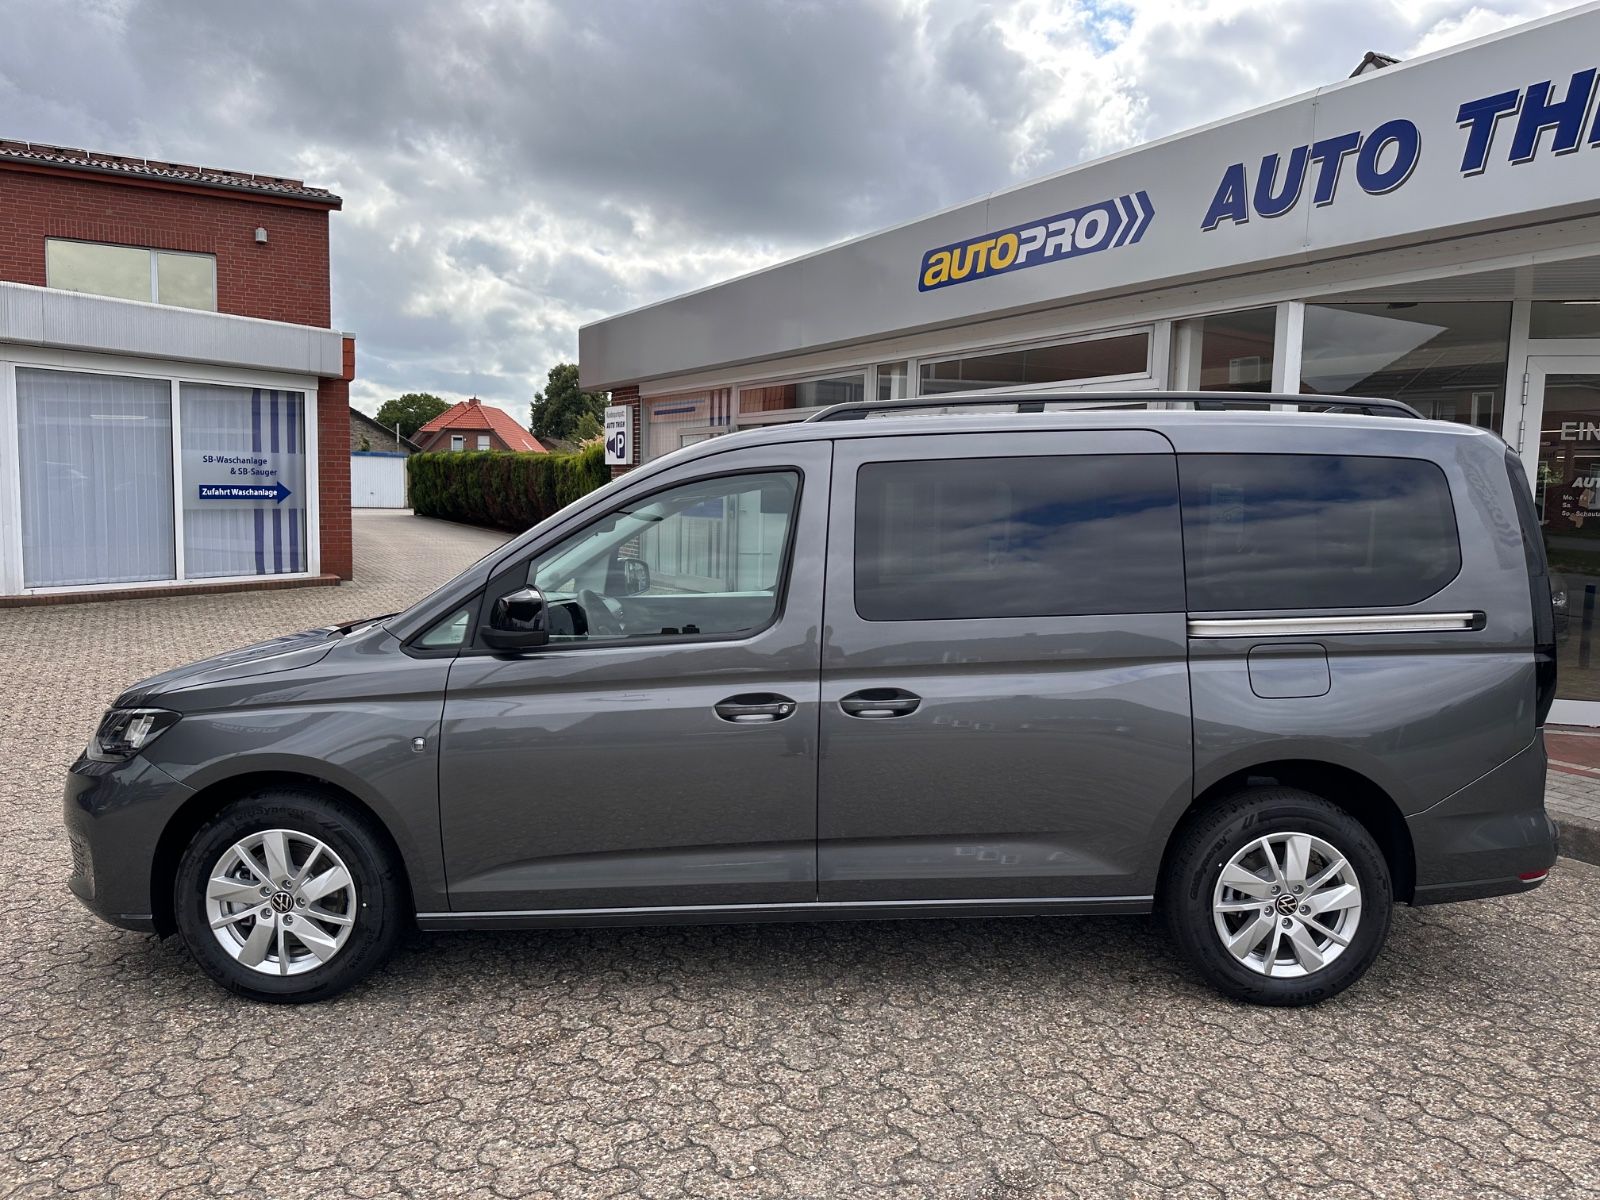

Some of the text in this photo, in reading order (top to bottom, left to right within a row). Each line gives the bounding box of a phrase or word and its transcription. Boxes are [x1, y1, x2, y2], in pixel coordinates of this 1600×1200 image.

[1200, 67, 1600, 232] AUTO TH
[617, 434, 624, 456] P
[202, 455, 268, 466] SB-Waschanlage
[230, 467, 278, 477] & SB-Sauger
[202, 488, 278, 497] Zufahrt Waschanlage
